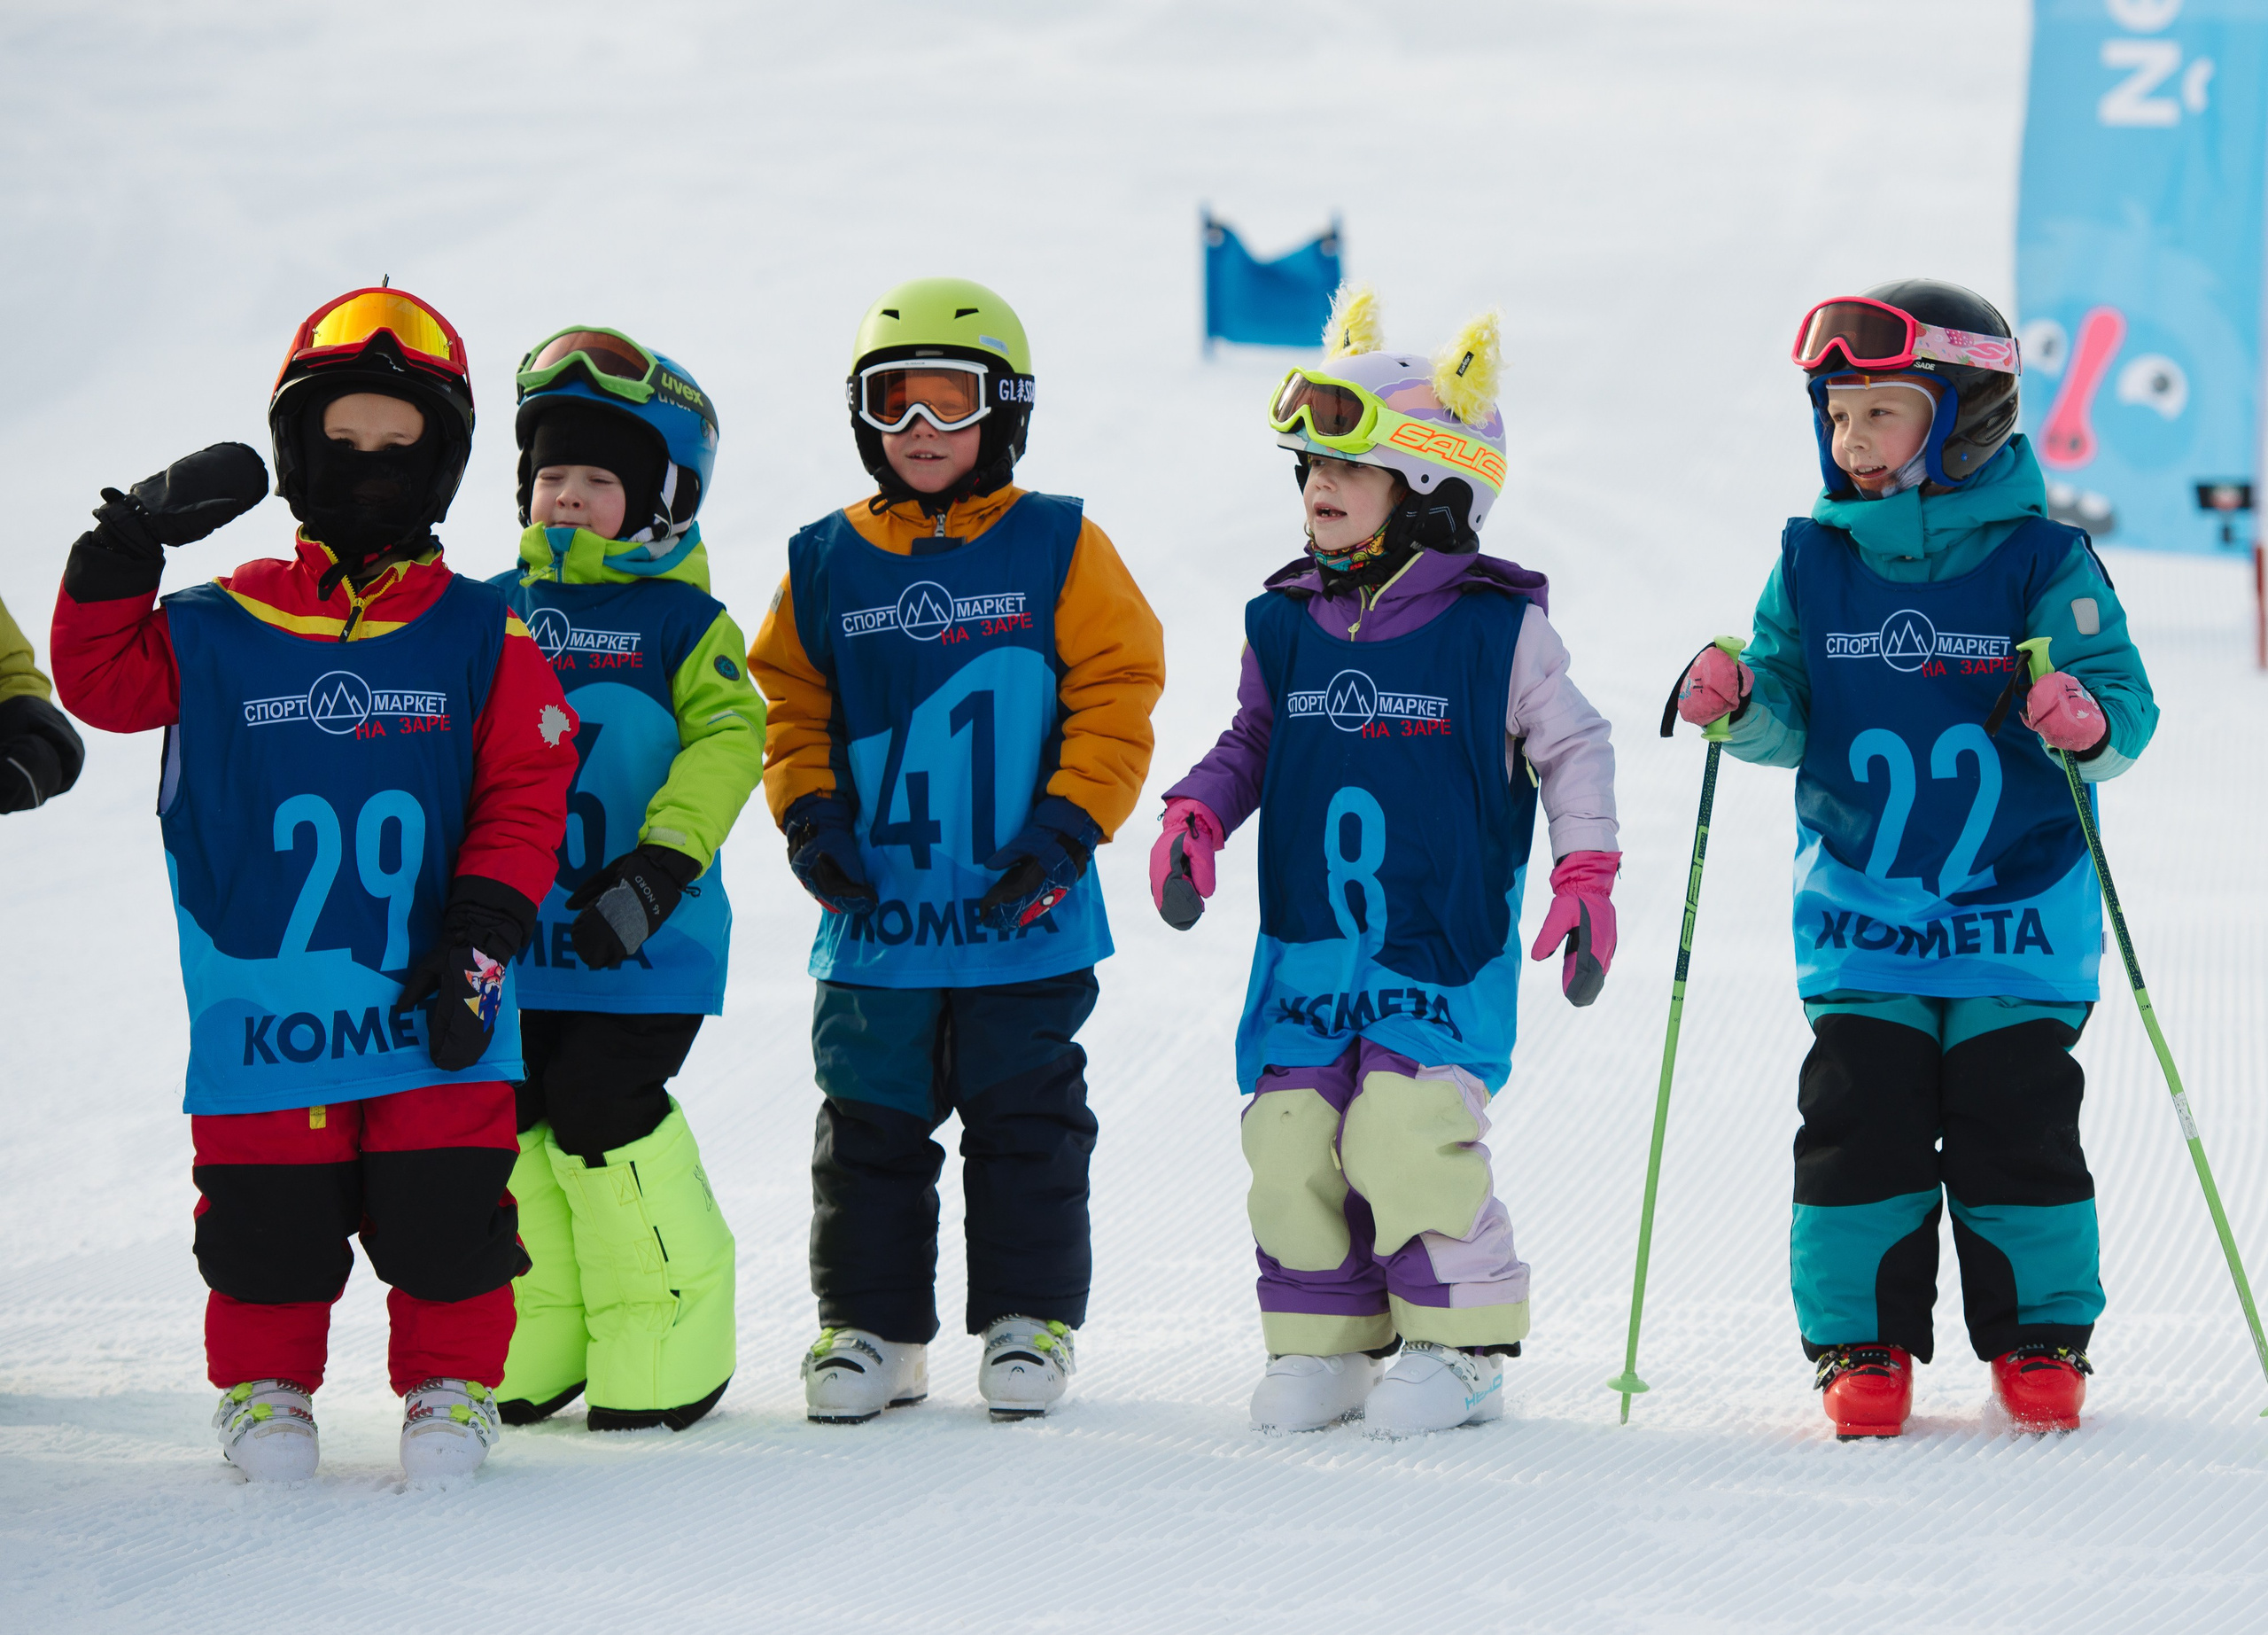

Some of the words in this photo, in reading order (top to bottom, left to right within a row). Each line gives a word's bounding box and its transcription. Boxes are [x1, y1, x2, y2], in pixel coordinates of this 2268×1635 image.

[661, 372, 704, 408] uvex
[843, 609, 897, 633] СПОРТ
[956, 596, 1027, 618] МАРКЕТ
[940, 626, 970, 646] НА
[980, 612, 1034, 636] ЗАРЕ
[570, 632, 641, 651] МАРКЕТ
[1826, 636, 1880, 654] СПОРТ
[1938, 636, 2011, 657] МАРКЕТ
[549, 654, 577, 671] НА
[589, 652, 644, 669] ЗАРЕ
[1922, 659, 1947, 678] НА
[1960, 656, 2015, 675] ЗАРЕ
[244, 699, 307, 722] СПОРТ
[374, 694, 447, 713] МАРКЕТ
[1379, 696, 1449, 718] МАРКЕТ
[354, 720, 387, 741] НА
[399, 714, 452, 735] ЗАРЕ
[1362, 720, 1391, 739] НА
[1400, 719, 1452, 737] ЗАРЕ
[869, 689, 997, 870] 41
[1849, 723, 2002, 899] 22
[273, 789, 425, 972] 29
[634, 875, 656, 903] NORD
[1324, 785, 1388, 960] 8
[1681, 825, 1709, 953] elan
[1814, 907, 2054, 960] КОМЕТА
[1464, 1373, 1503, 1412] HEAD
